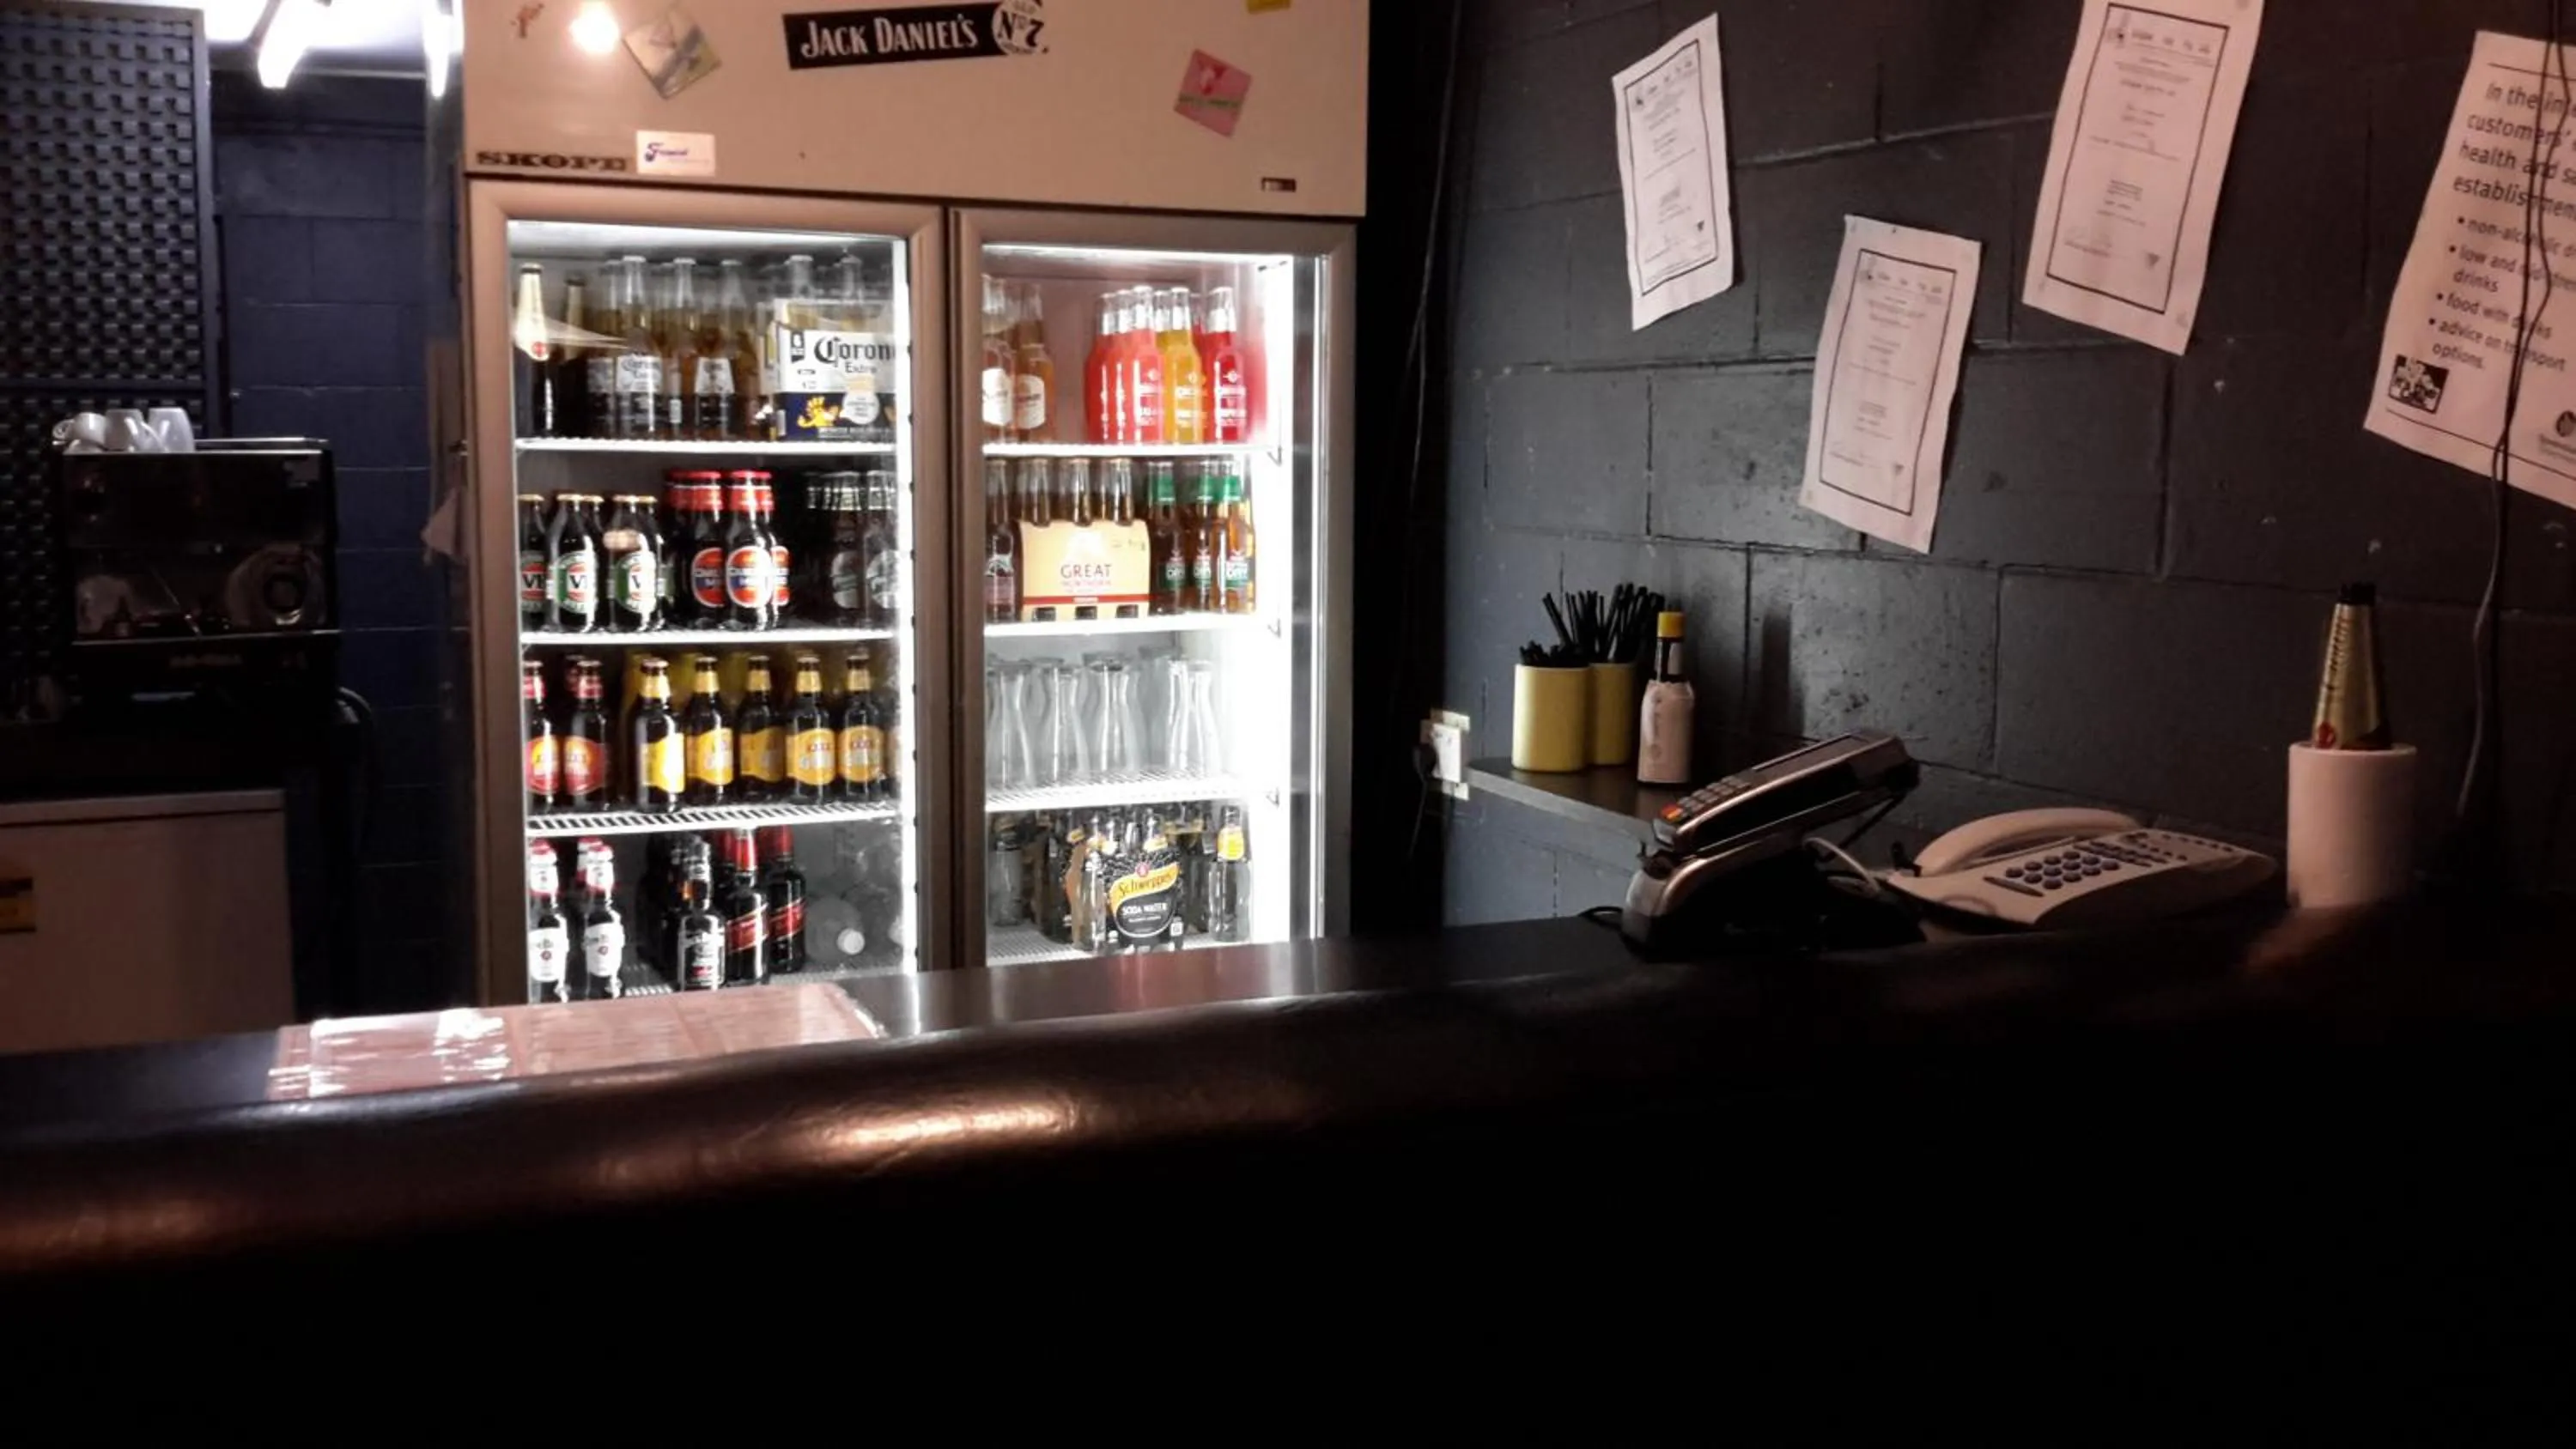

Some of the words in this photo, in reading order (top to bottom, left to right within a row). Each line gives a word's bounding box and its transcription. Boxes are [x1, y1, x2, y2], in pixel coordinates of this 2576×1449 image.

[801, 21, 868, 59] JACK
[873, 13, 978, 54] DANIEL'S
[2506, 87, 2539, 110] the
[476, 151, 628, 171] SKOPE
[2459, 139, 2516, 170] health
[2453, 268, 2499, 293] drinks
[2447, 292, 2480, 315] food
[2439, 320, 2483, 343] advice
[814, 336, 895, 367] Coron
[1060, 562, 1113, 579] GREAT
